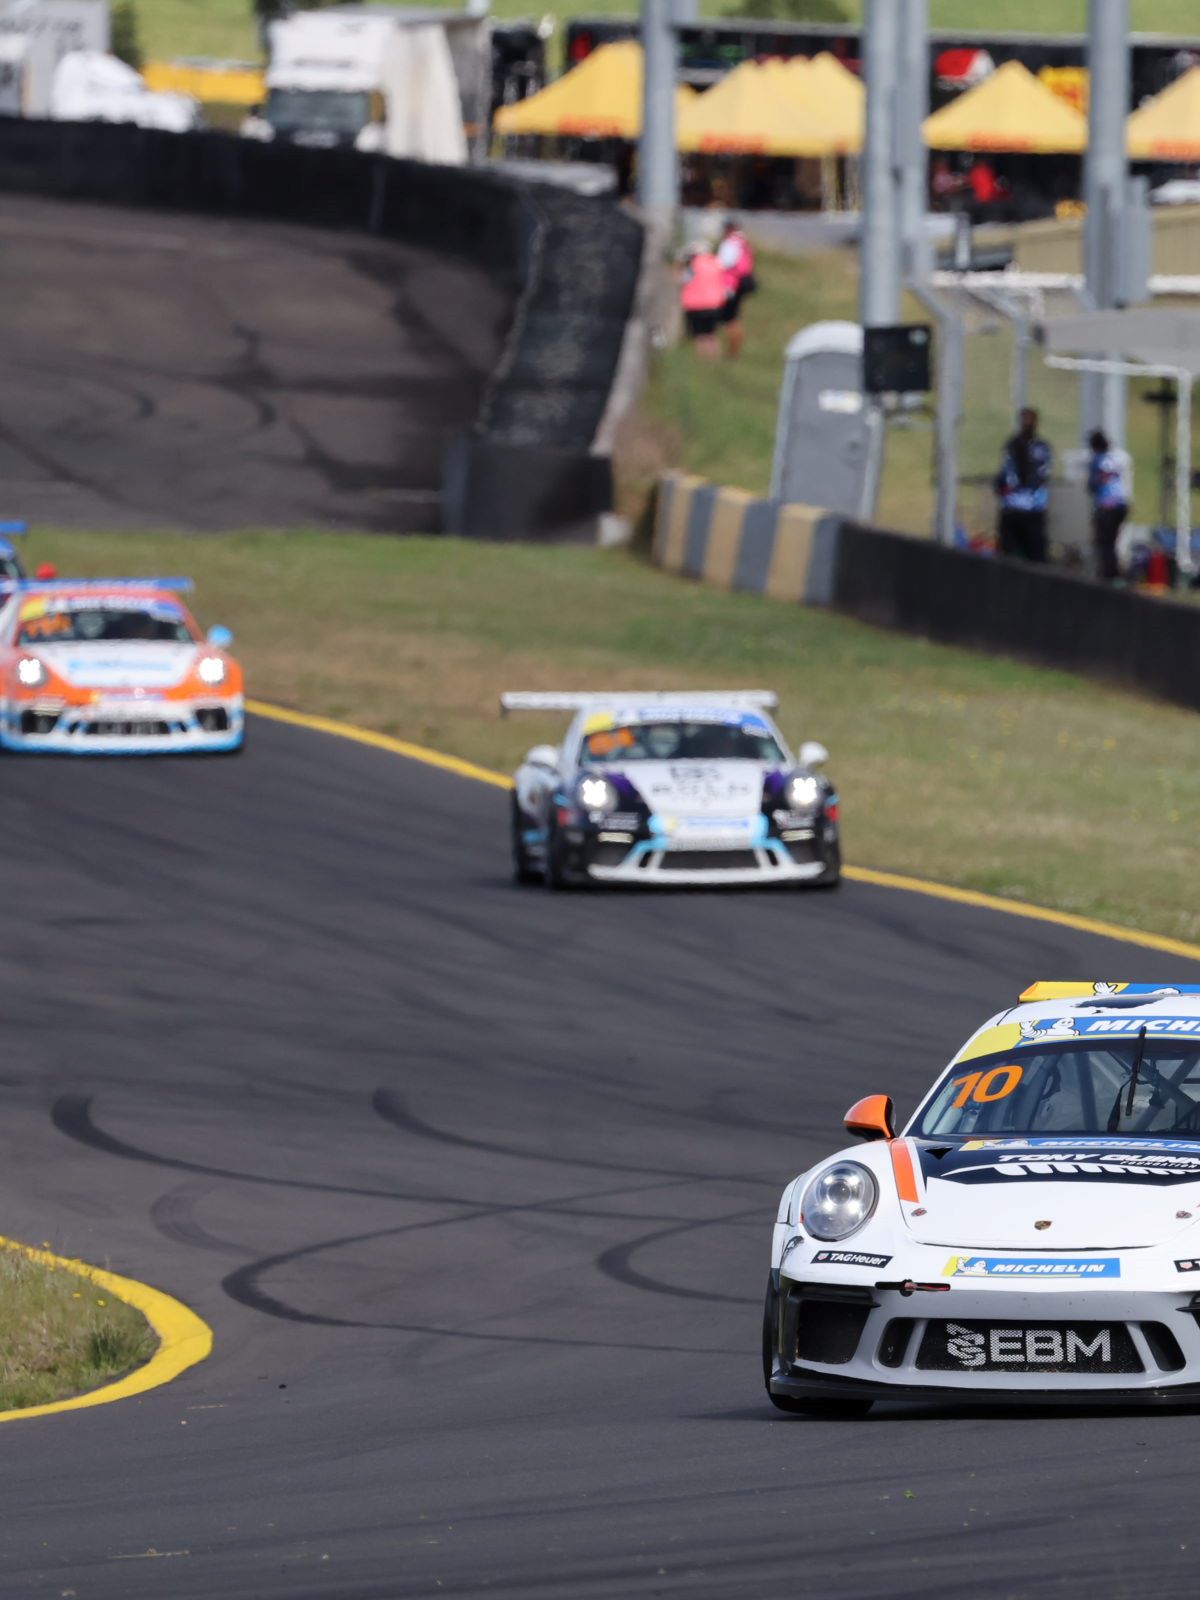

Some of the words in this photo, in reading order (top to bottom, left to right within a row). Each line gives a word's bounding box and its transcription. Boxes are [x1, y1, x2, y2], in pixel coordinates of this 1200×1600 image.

[951, 1064, 1023, 1109] 10
[998, 1153, 1101, 1162] TONY
[1119, 1159, 1200, 1169] FOUNDATION
[991, 1262, 1107, 1274] MICHELIN
[989, 1328, 1112, 1364] EBM
